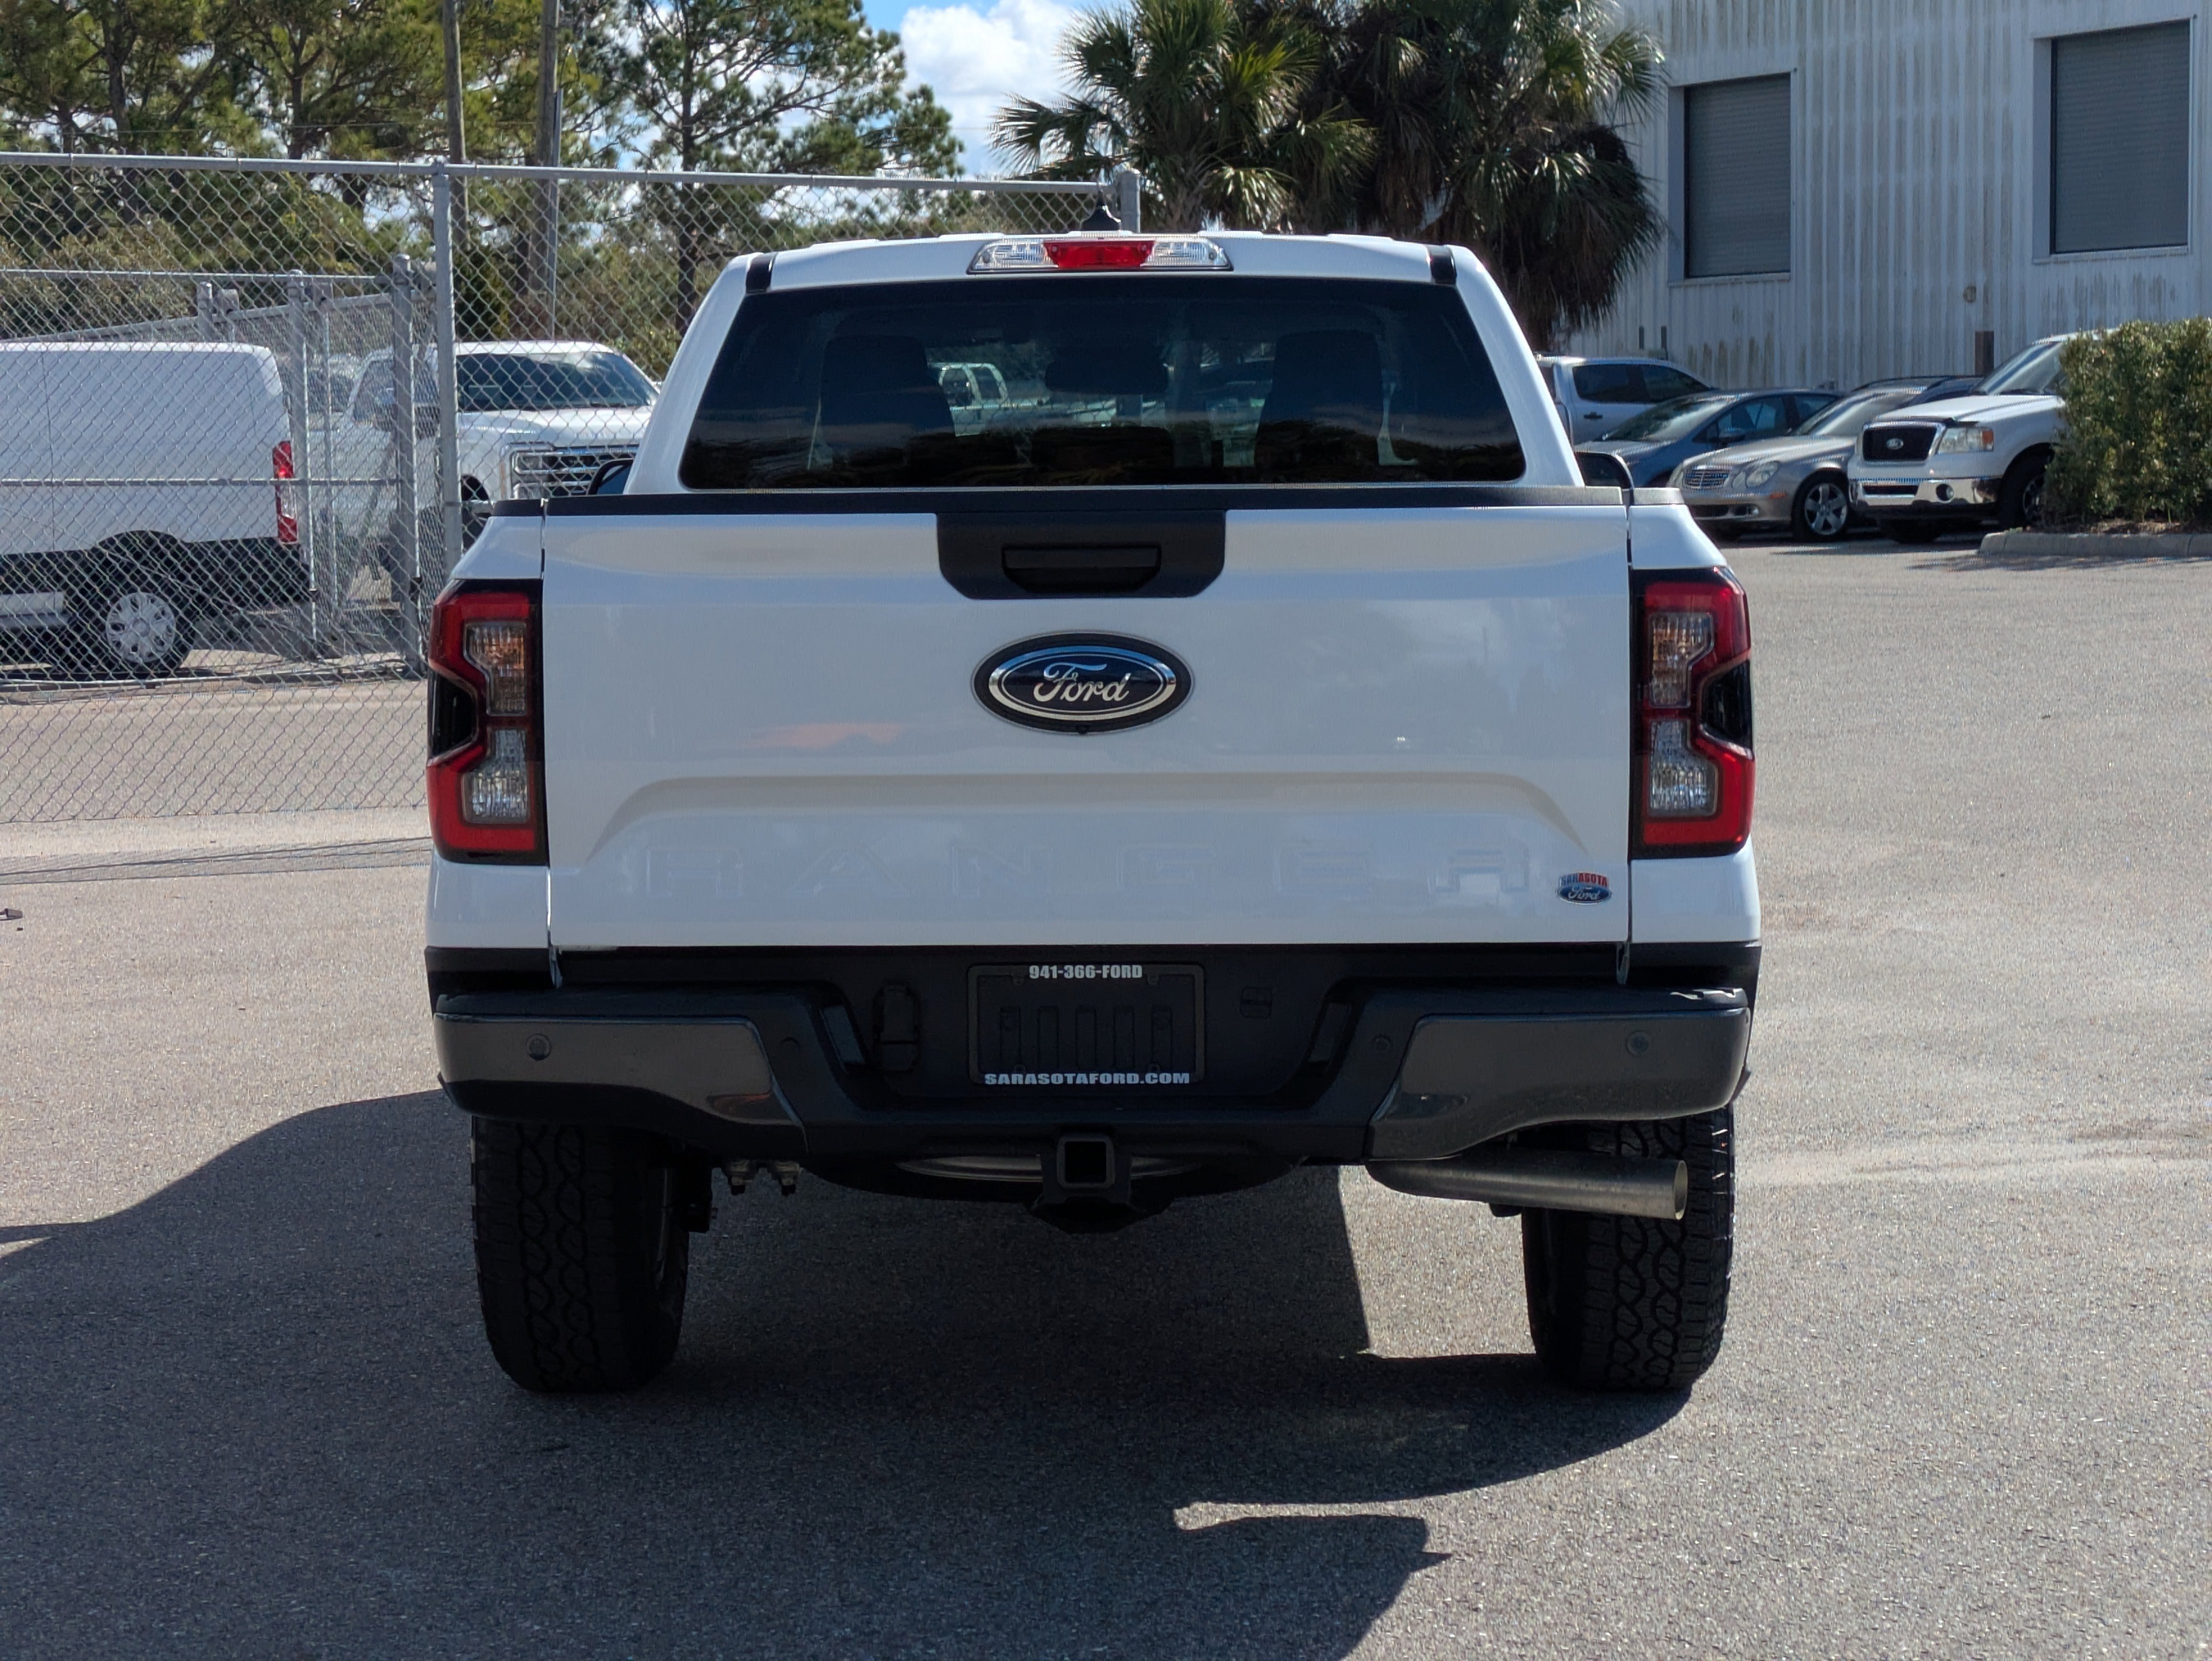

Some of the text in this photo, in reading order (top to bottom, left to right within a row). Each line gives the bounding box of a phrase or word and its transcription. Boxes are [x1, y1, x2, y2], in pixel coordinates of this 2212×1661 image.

[1033, 662, 1132, 702] Ford
[644, 843, 1529, 897] RANGER
[1568, 885, 1601, 900] Ford
[1029, 965, 1143, 979] 941-366-FORD
[984, 1073, 1190, 1085] SARASOTAFORD.COM
